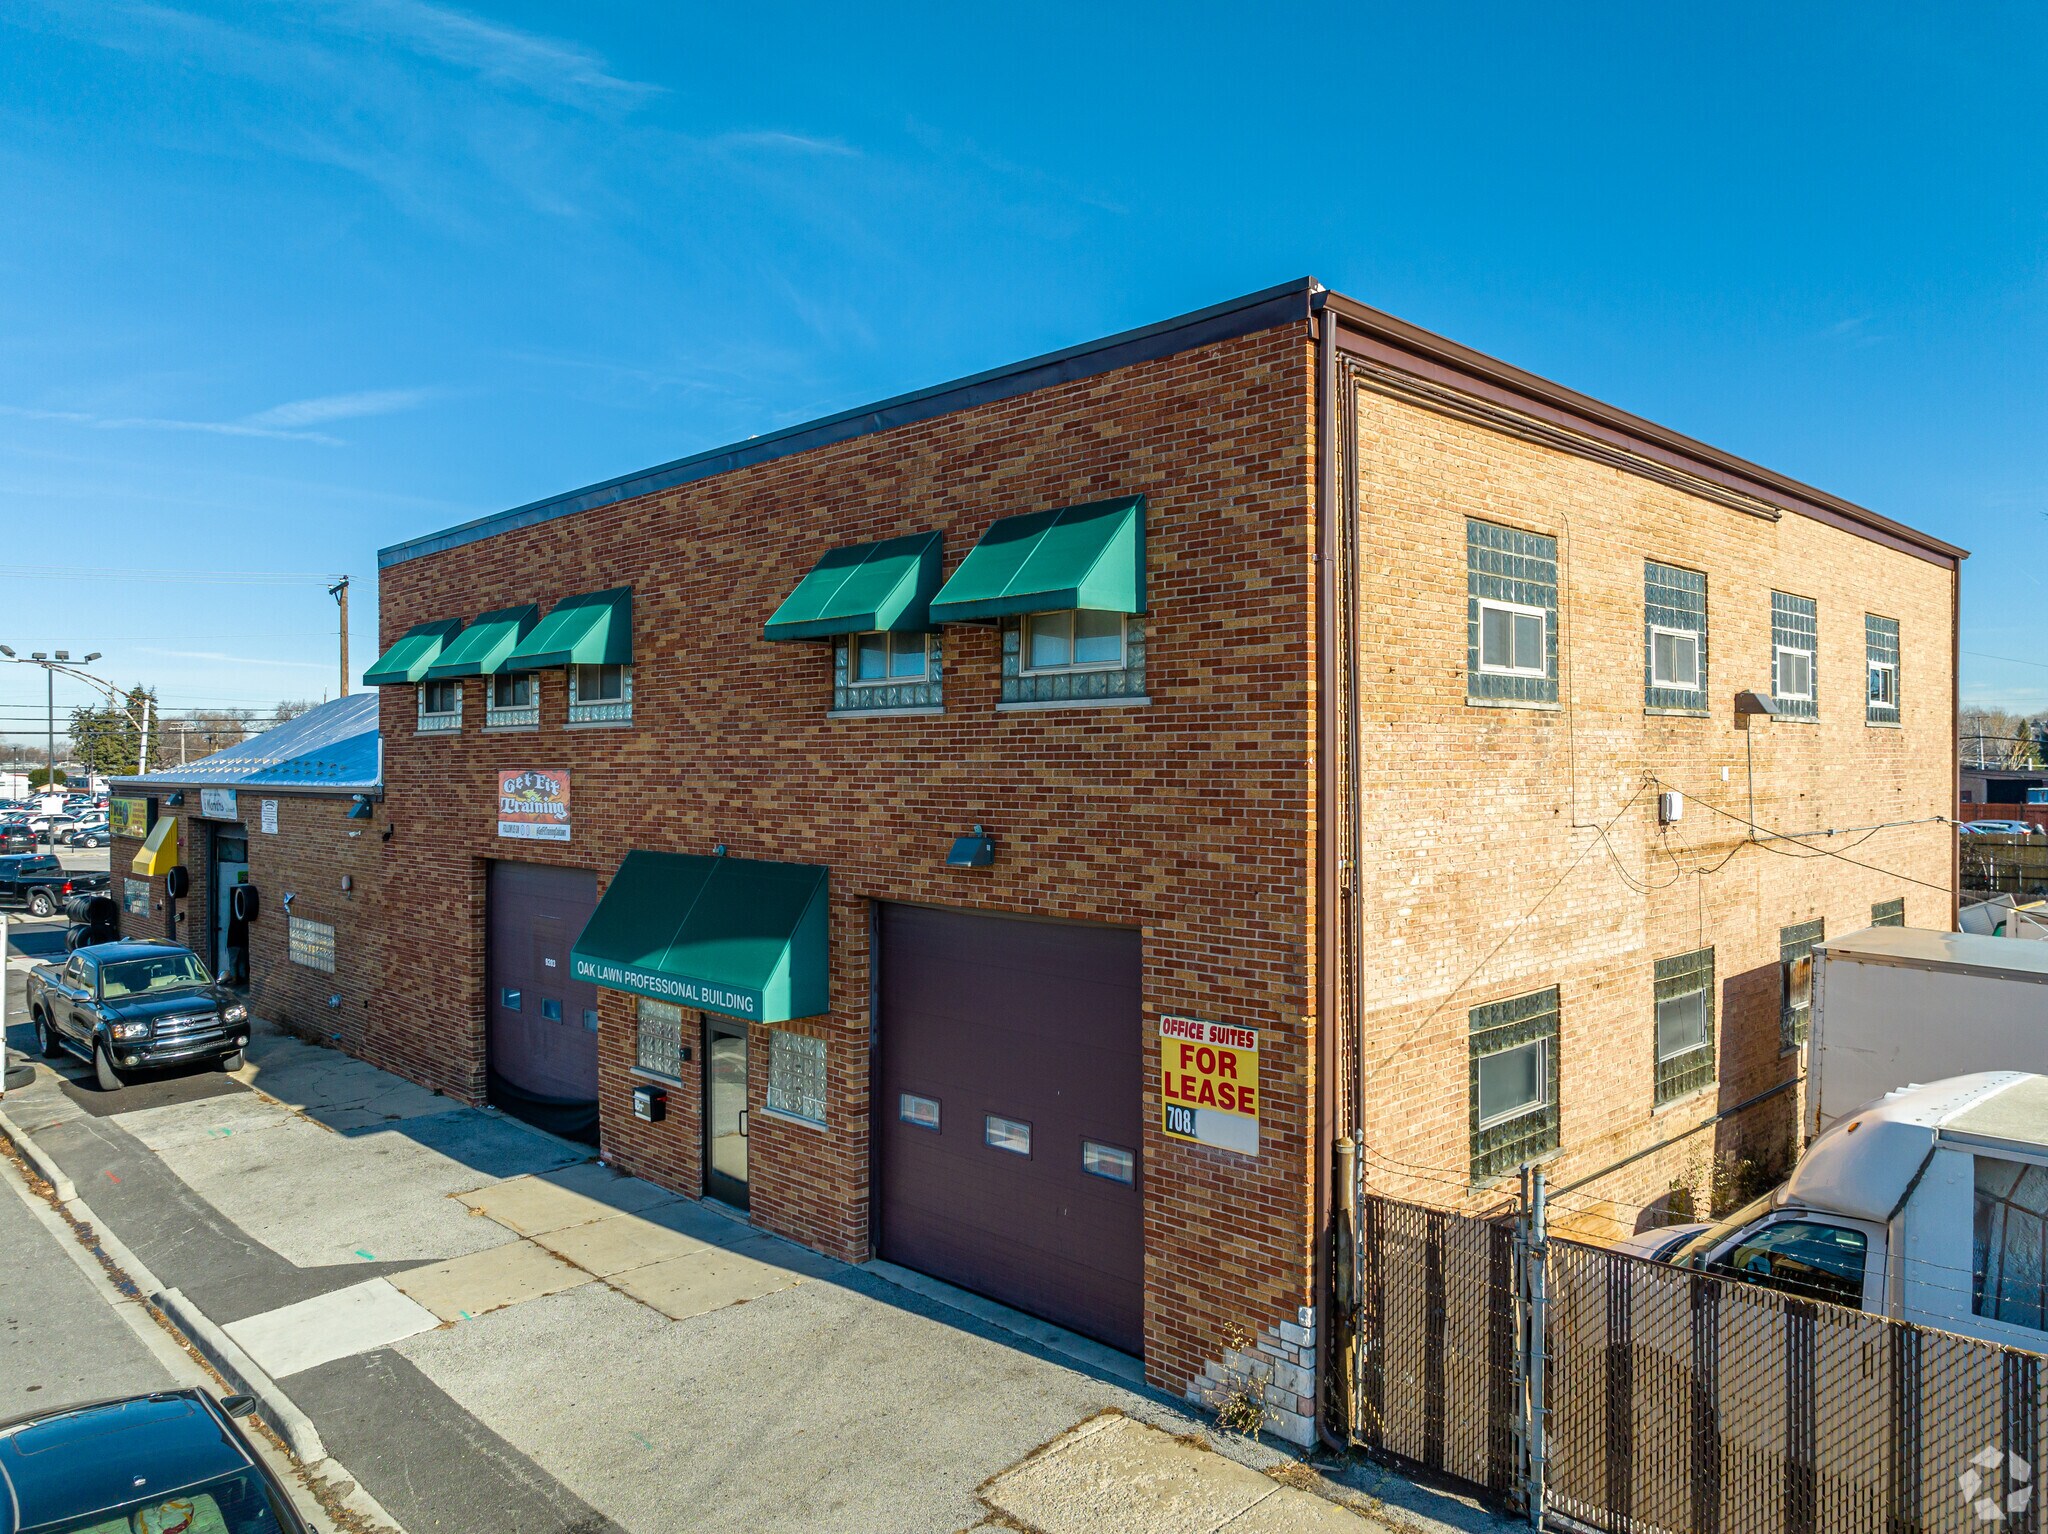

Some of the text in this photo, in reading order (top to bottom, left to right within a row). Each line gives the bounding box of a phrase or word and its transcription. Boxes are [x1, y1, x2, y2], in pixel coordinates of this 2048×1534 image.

[503, 773, 560, 796] Get Fit
[500, 796, 568, 820] Training
[577, 960, 753, 1013] OAK LAWN PROFESSIONAL BUILDING
[1162, 1017, 1255, 1049] OFFICE SUITES
[1180, 1043, 1238, 1080] FOR
[1164, 1071, 1256, 1115] LEASE
[1167, 1106, 1195, 1135] 708.
